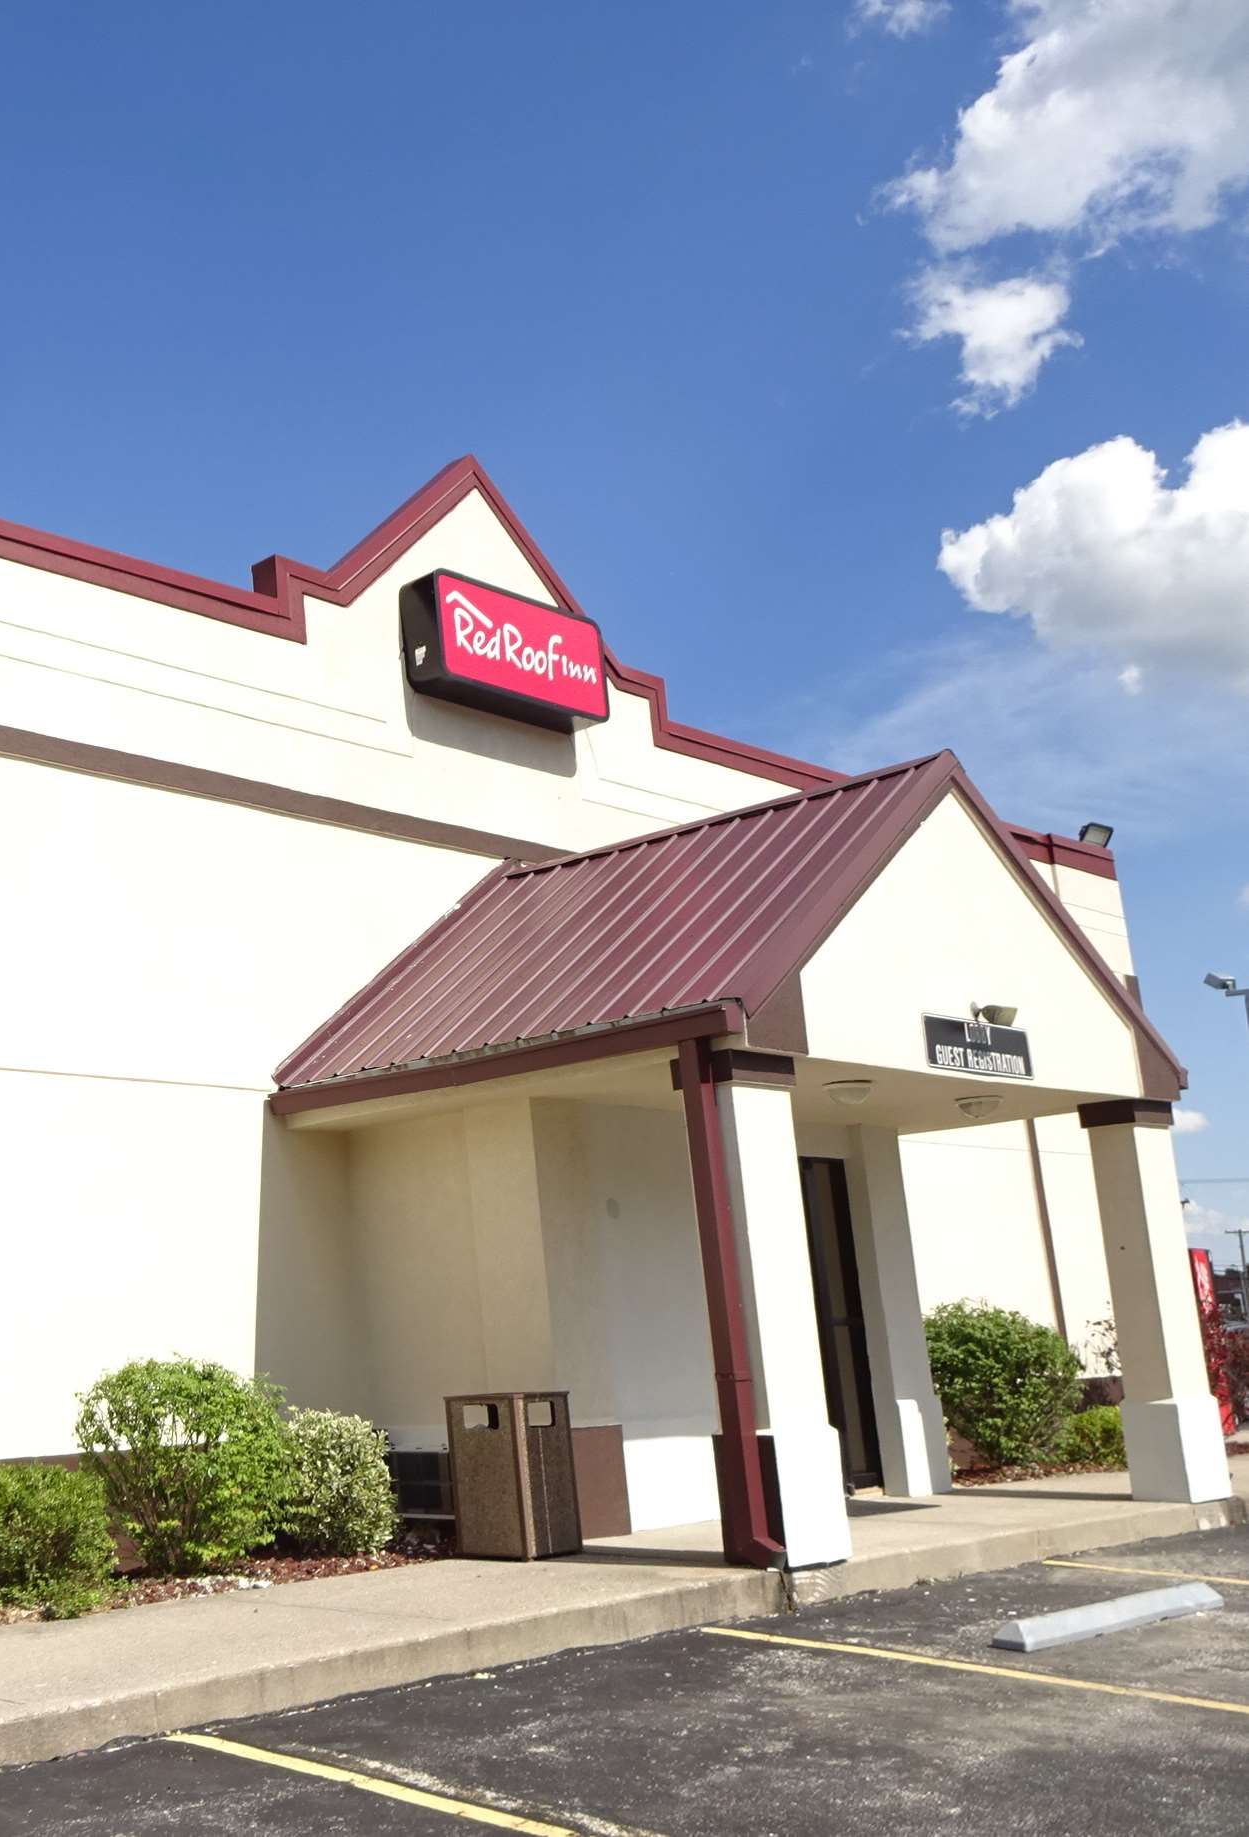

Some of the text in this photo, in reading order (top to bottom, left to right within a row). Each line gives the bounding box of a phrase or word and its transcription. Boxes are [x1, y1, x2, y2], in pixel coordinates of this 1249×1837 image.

[454, 607, 501, 660] Red
[503, 623, 562, 680] Roof
[935, 1044, 1026, 1075] GUEST REGISTRATION
